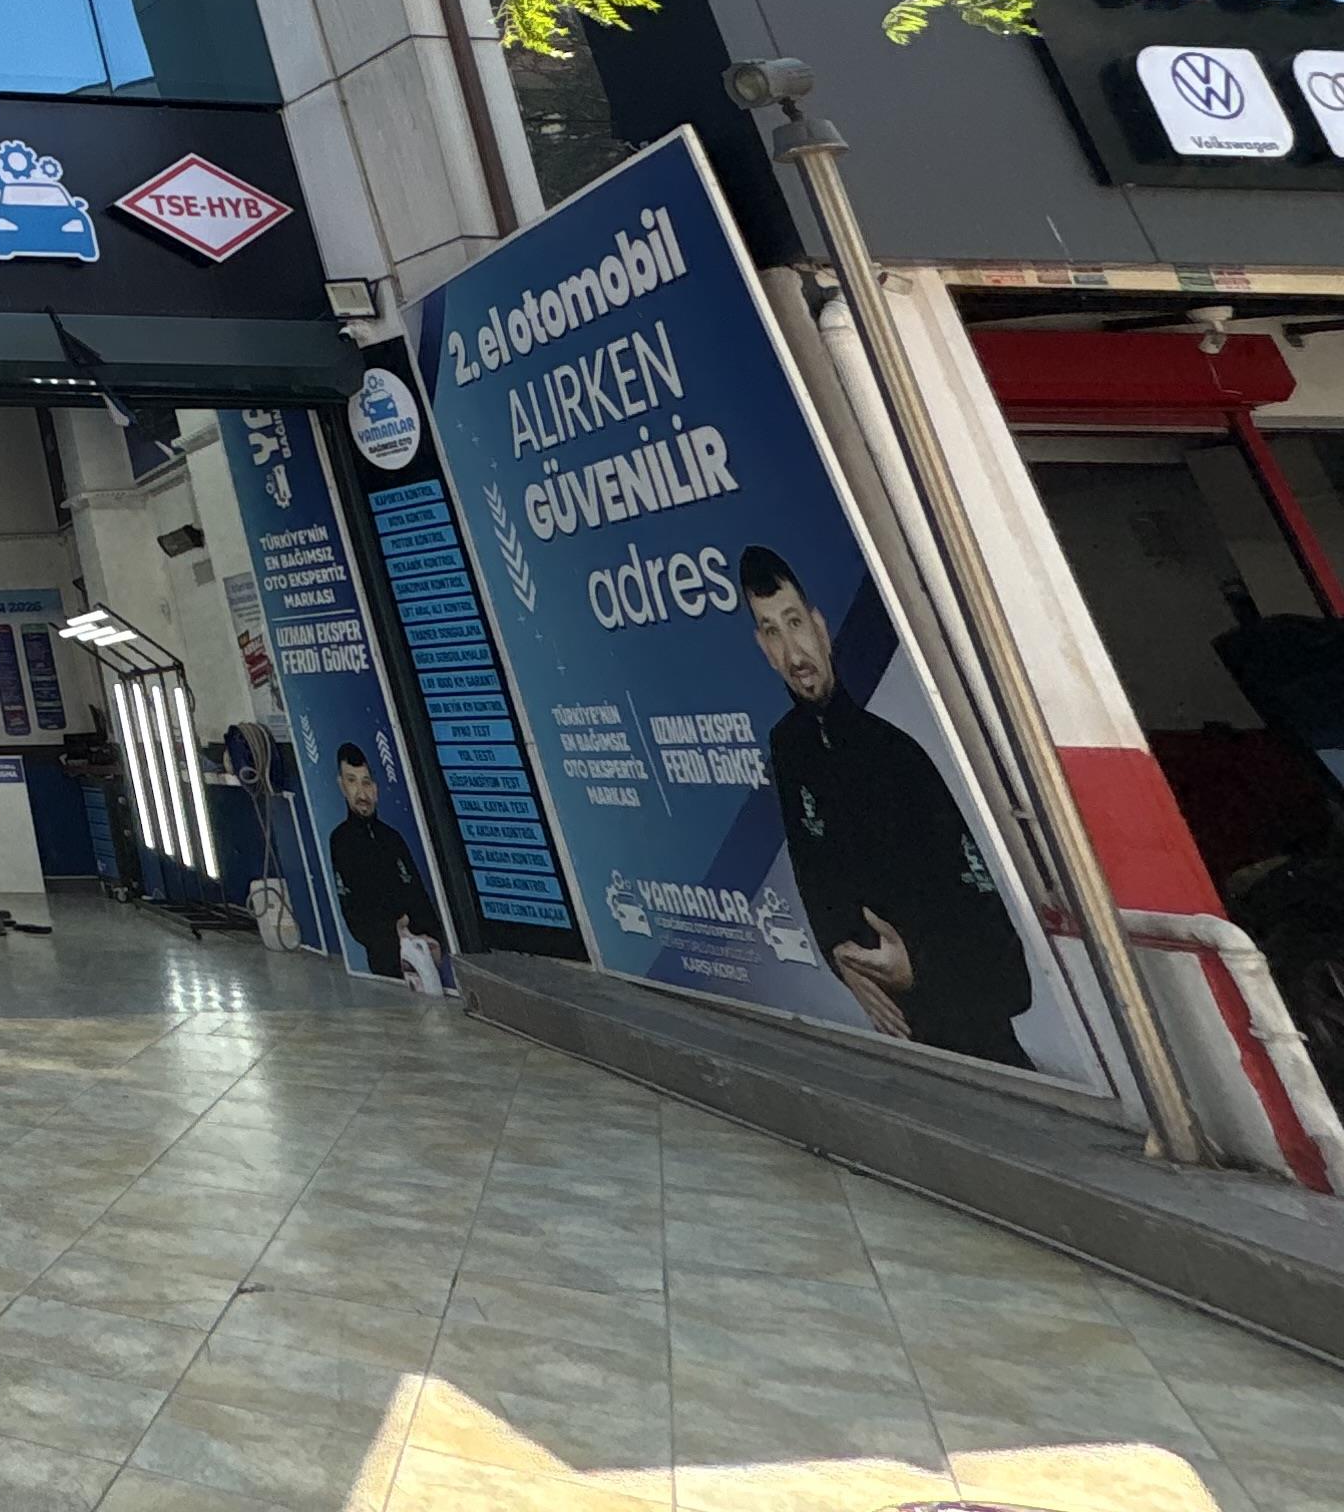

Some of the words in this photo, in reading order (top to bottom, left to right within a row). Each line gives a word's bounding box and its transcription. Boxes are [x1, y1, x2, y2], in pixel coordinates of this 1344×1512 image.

[1189, 133, 1280, 154] Volkswagen
[148, 193, 264, 220] TSE-HYB
[508, 206, 688, 358] otomobil
[509, 320, 685, 460] ALIRKEN
[357, 417, 417, 444] YAMANLAR
[524, 414, 739, 541] GÜVENİLİR
[264, 556, 279, 571] EN
[263, 576, 288, 592] OTO
[588, 543, 738, 629] adres
[284, 589, 336, 609] MARKASI
[275, 625, 316, 648] UZMAN
[317, 619, 362, 643] EKSPER
[649, 715, 699, 745] UZMAN
[698, 712, 757, 744] EKSPER
[563, 759, 589, 778] OTO
[586, 786, 641, 807] MARKASI
[637, 879, 756, 926] YAMANLAR
